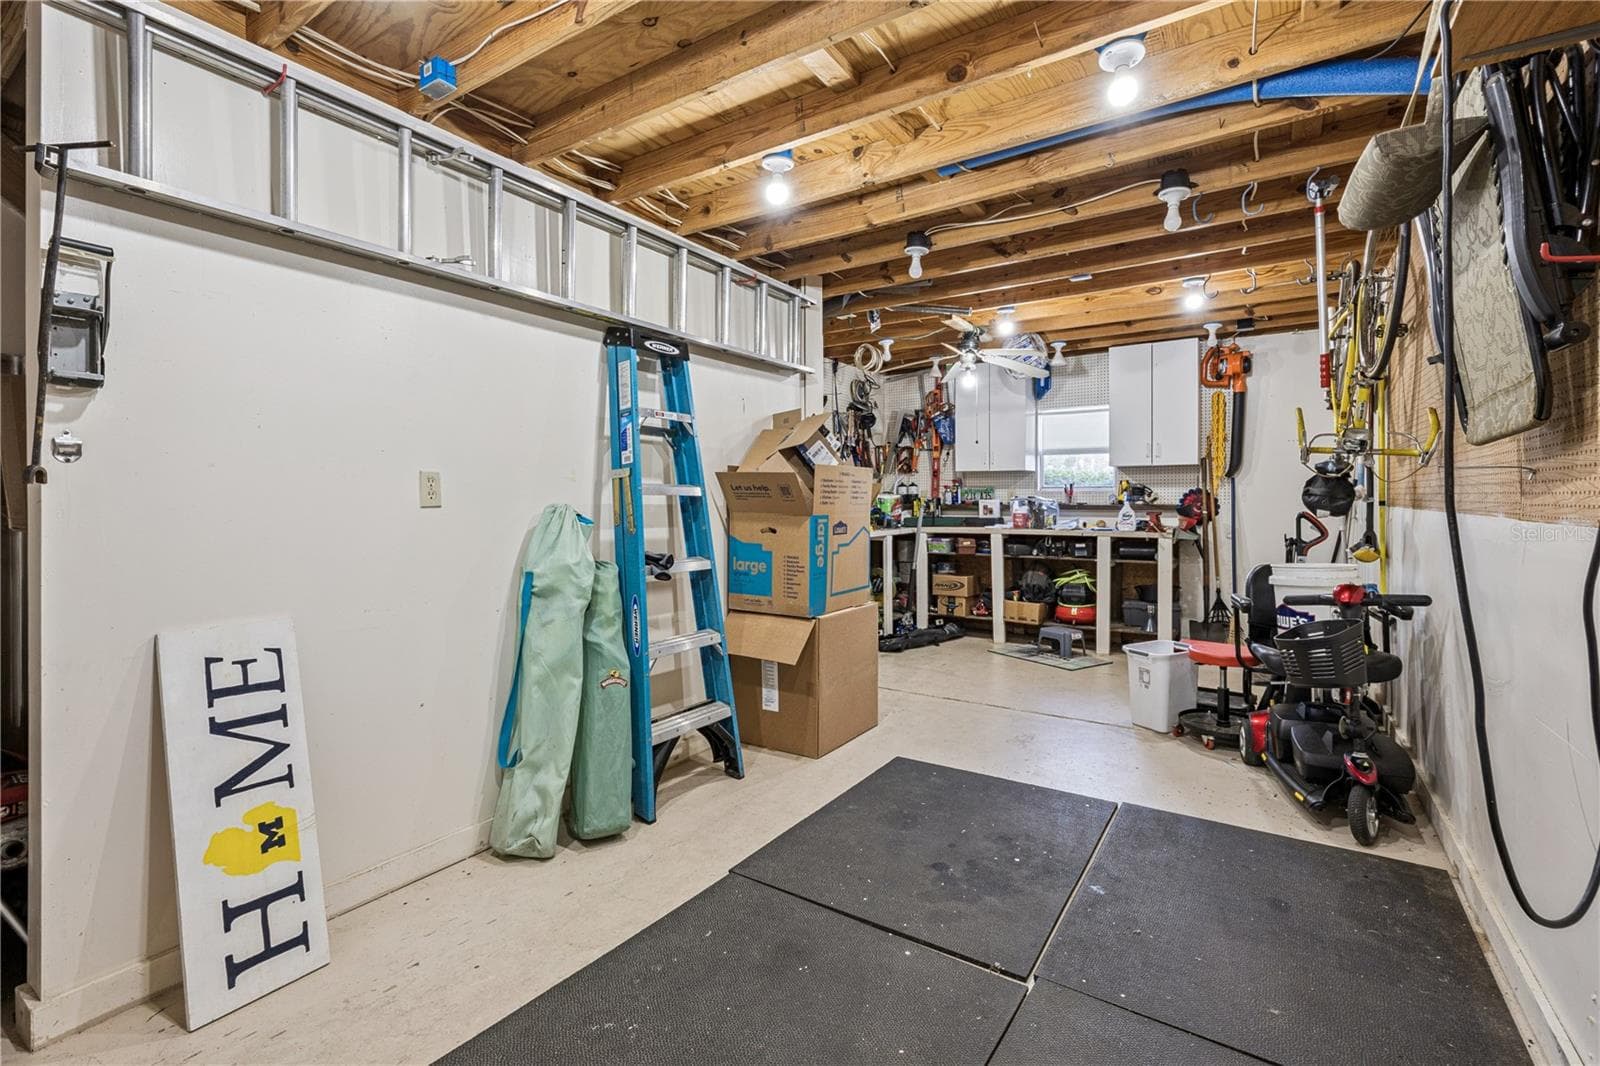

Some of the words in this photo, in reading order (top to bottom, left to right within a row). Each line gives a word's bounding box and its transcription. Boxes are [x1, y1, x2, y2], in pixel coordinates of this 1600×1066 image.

[816, 518, 828, 568] large
[732, 556, 768, 576] large
[632, 608, 641, 644] WERNER
[257, 815, 287, 855] M
